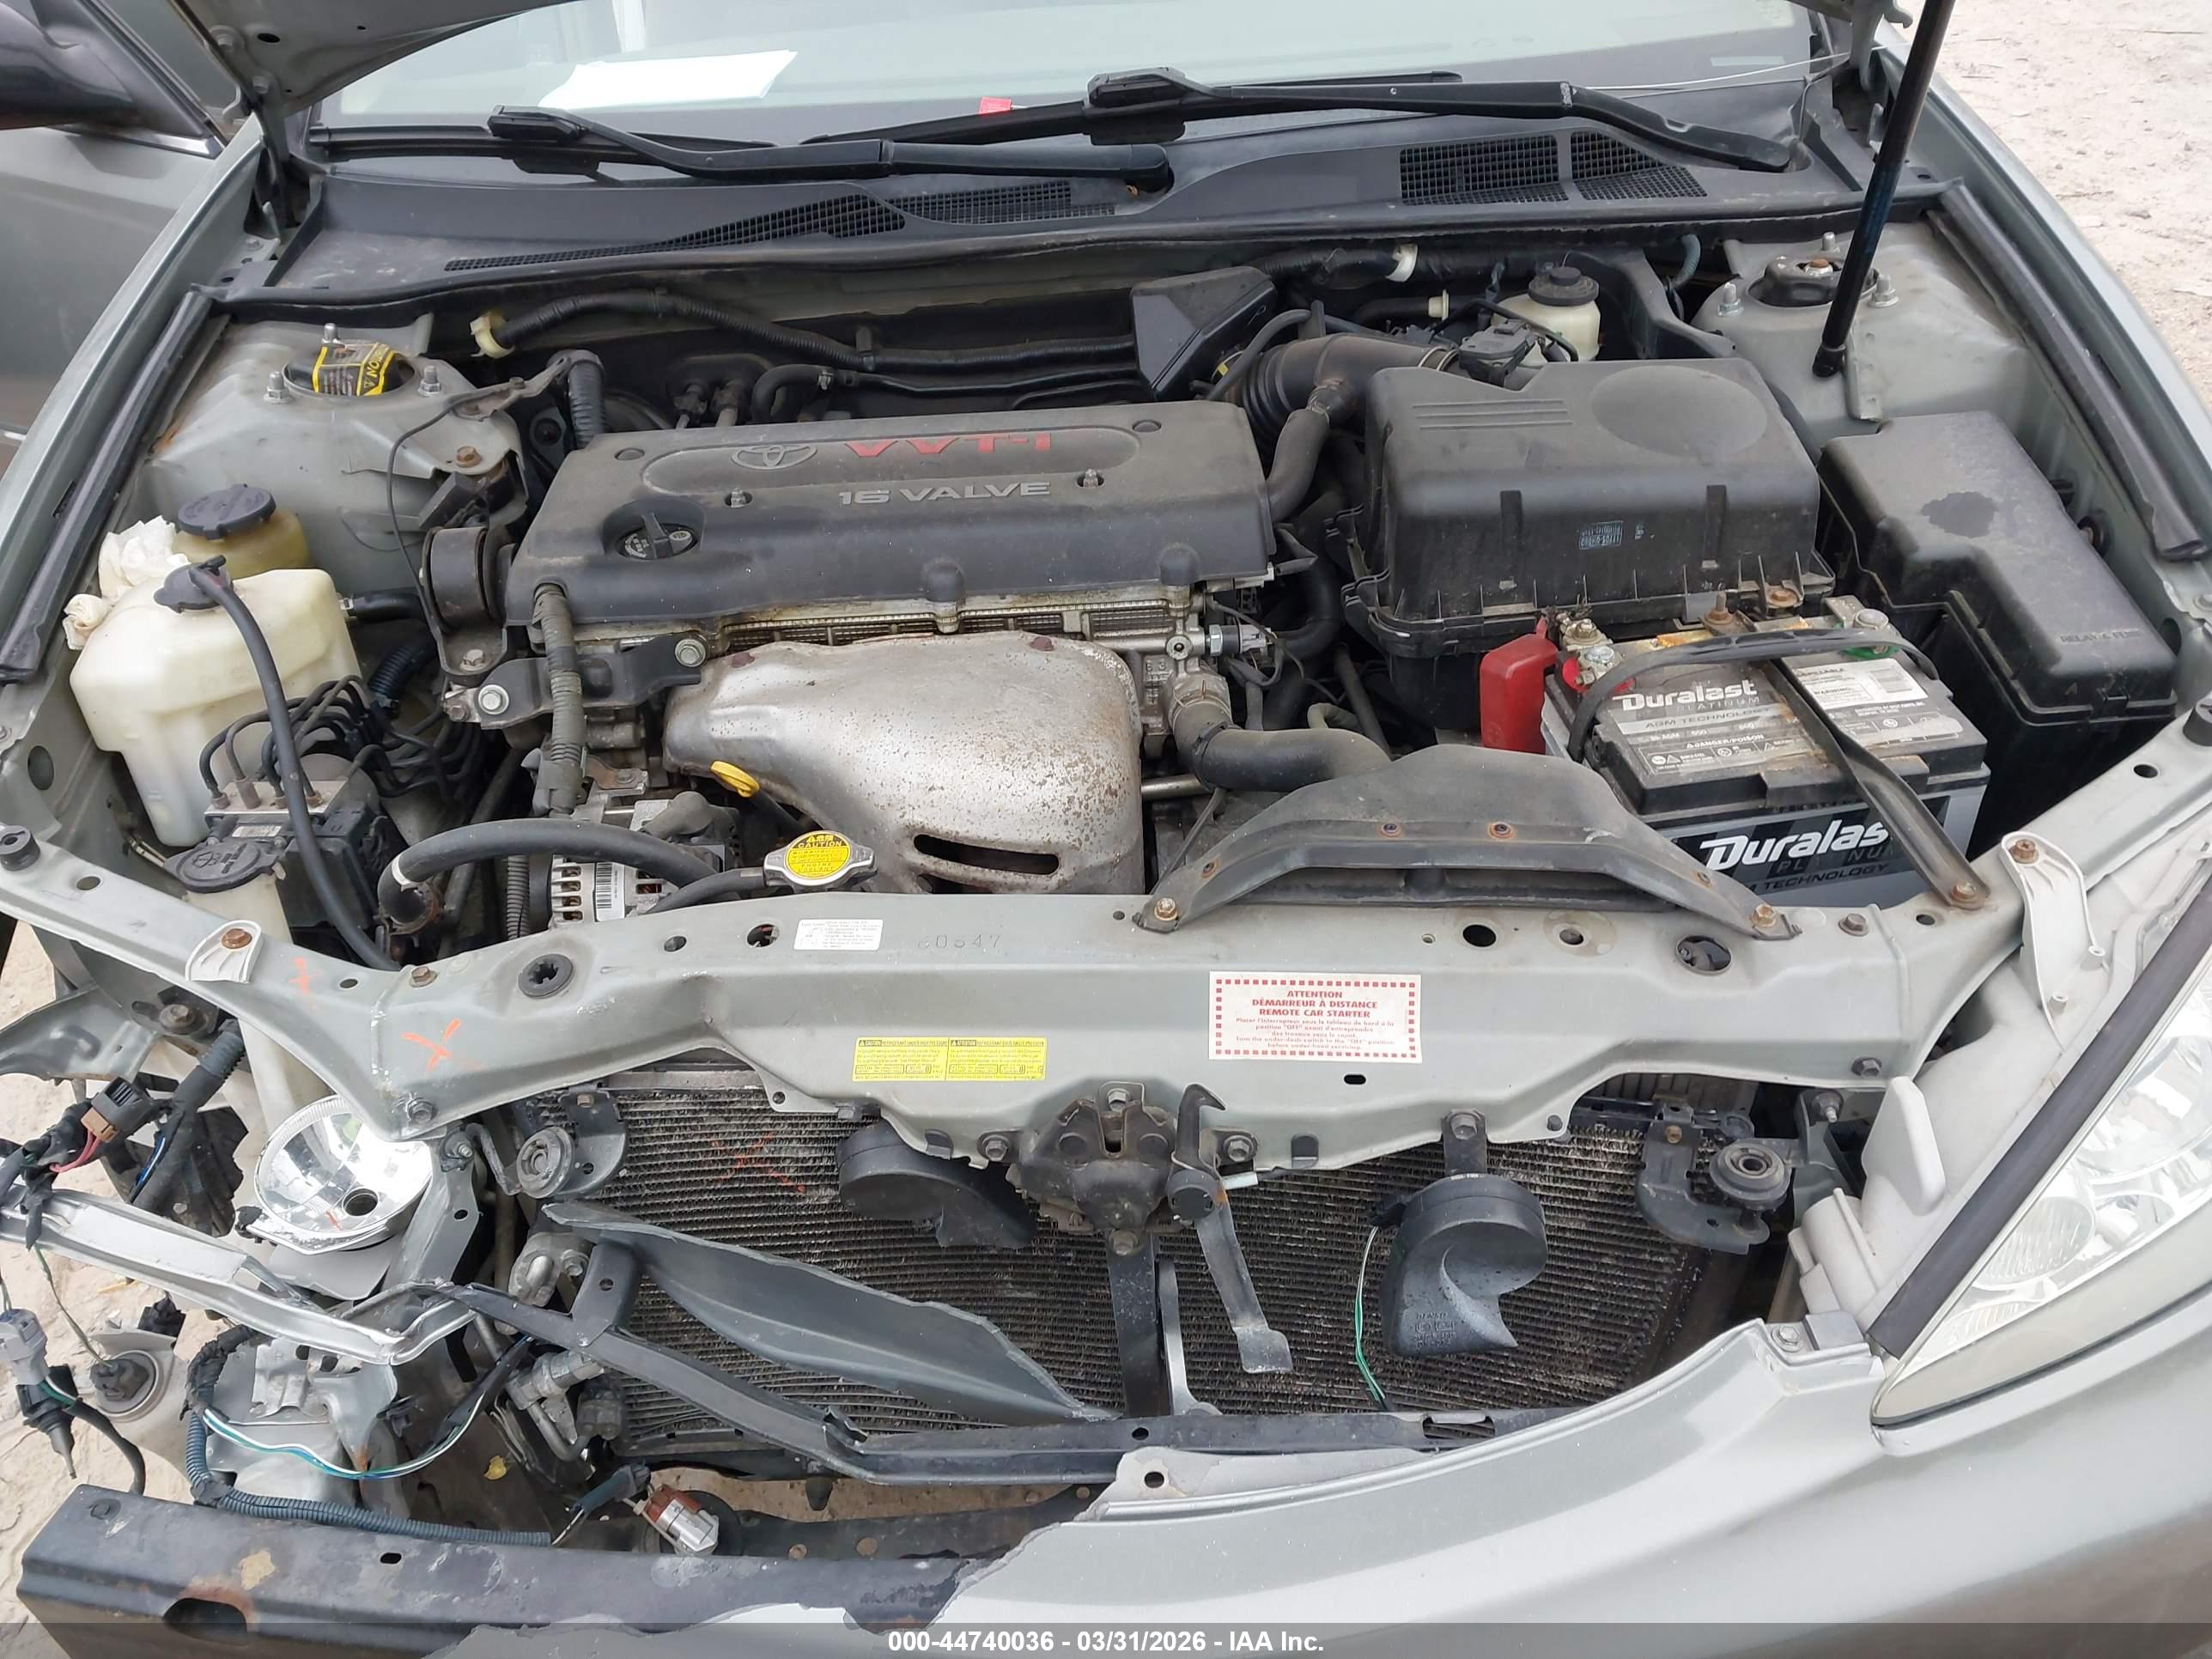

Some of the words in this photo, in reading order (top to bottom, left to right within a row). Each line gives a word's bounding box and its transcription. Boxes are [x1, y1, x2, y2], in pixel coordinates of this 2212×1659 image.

[838, 489, 891, 506] 16
[899, 481, 1050, 501] VALVE
[1612, 679, 1758, 712] Duralast
[1644, 719, 1676, 729] AGM
[1681, 707, 1771, 725] TECHNOLOGY
[1699, 819, 1889, 871] Duralas
[1763, 862, 1889, 891] TECHNOLOGY
[1252, 997, 1316, 1007] DÉMARREUR
[1319, 998, 1326, 1007] À
[1329, 1000, 1378, 1009] DISTANCE
[1286, 990, 1343, 999] ATTENTION
[1327, 1010, 1371, 1018] STARTER
